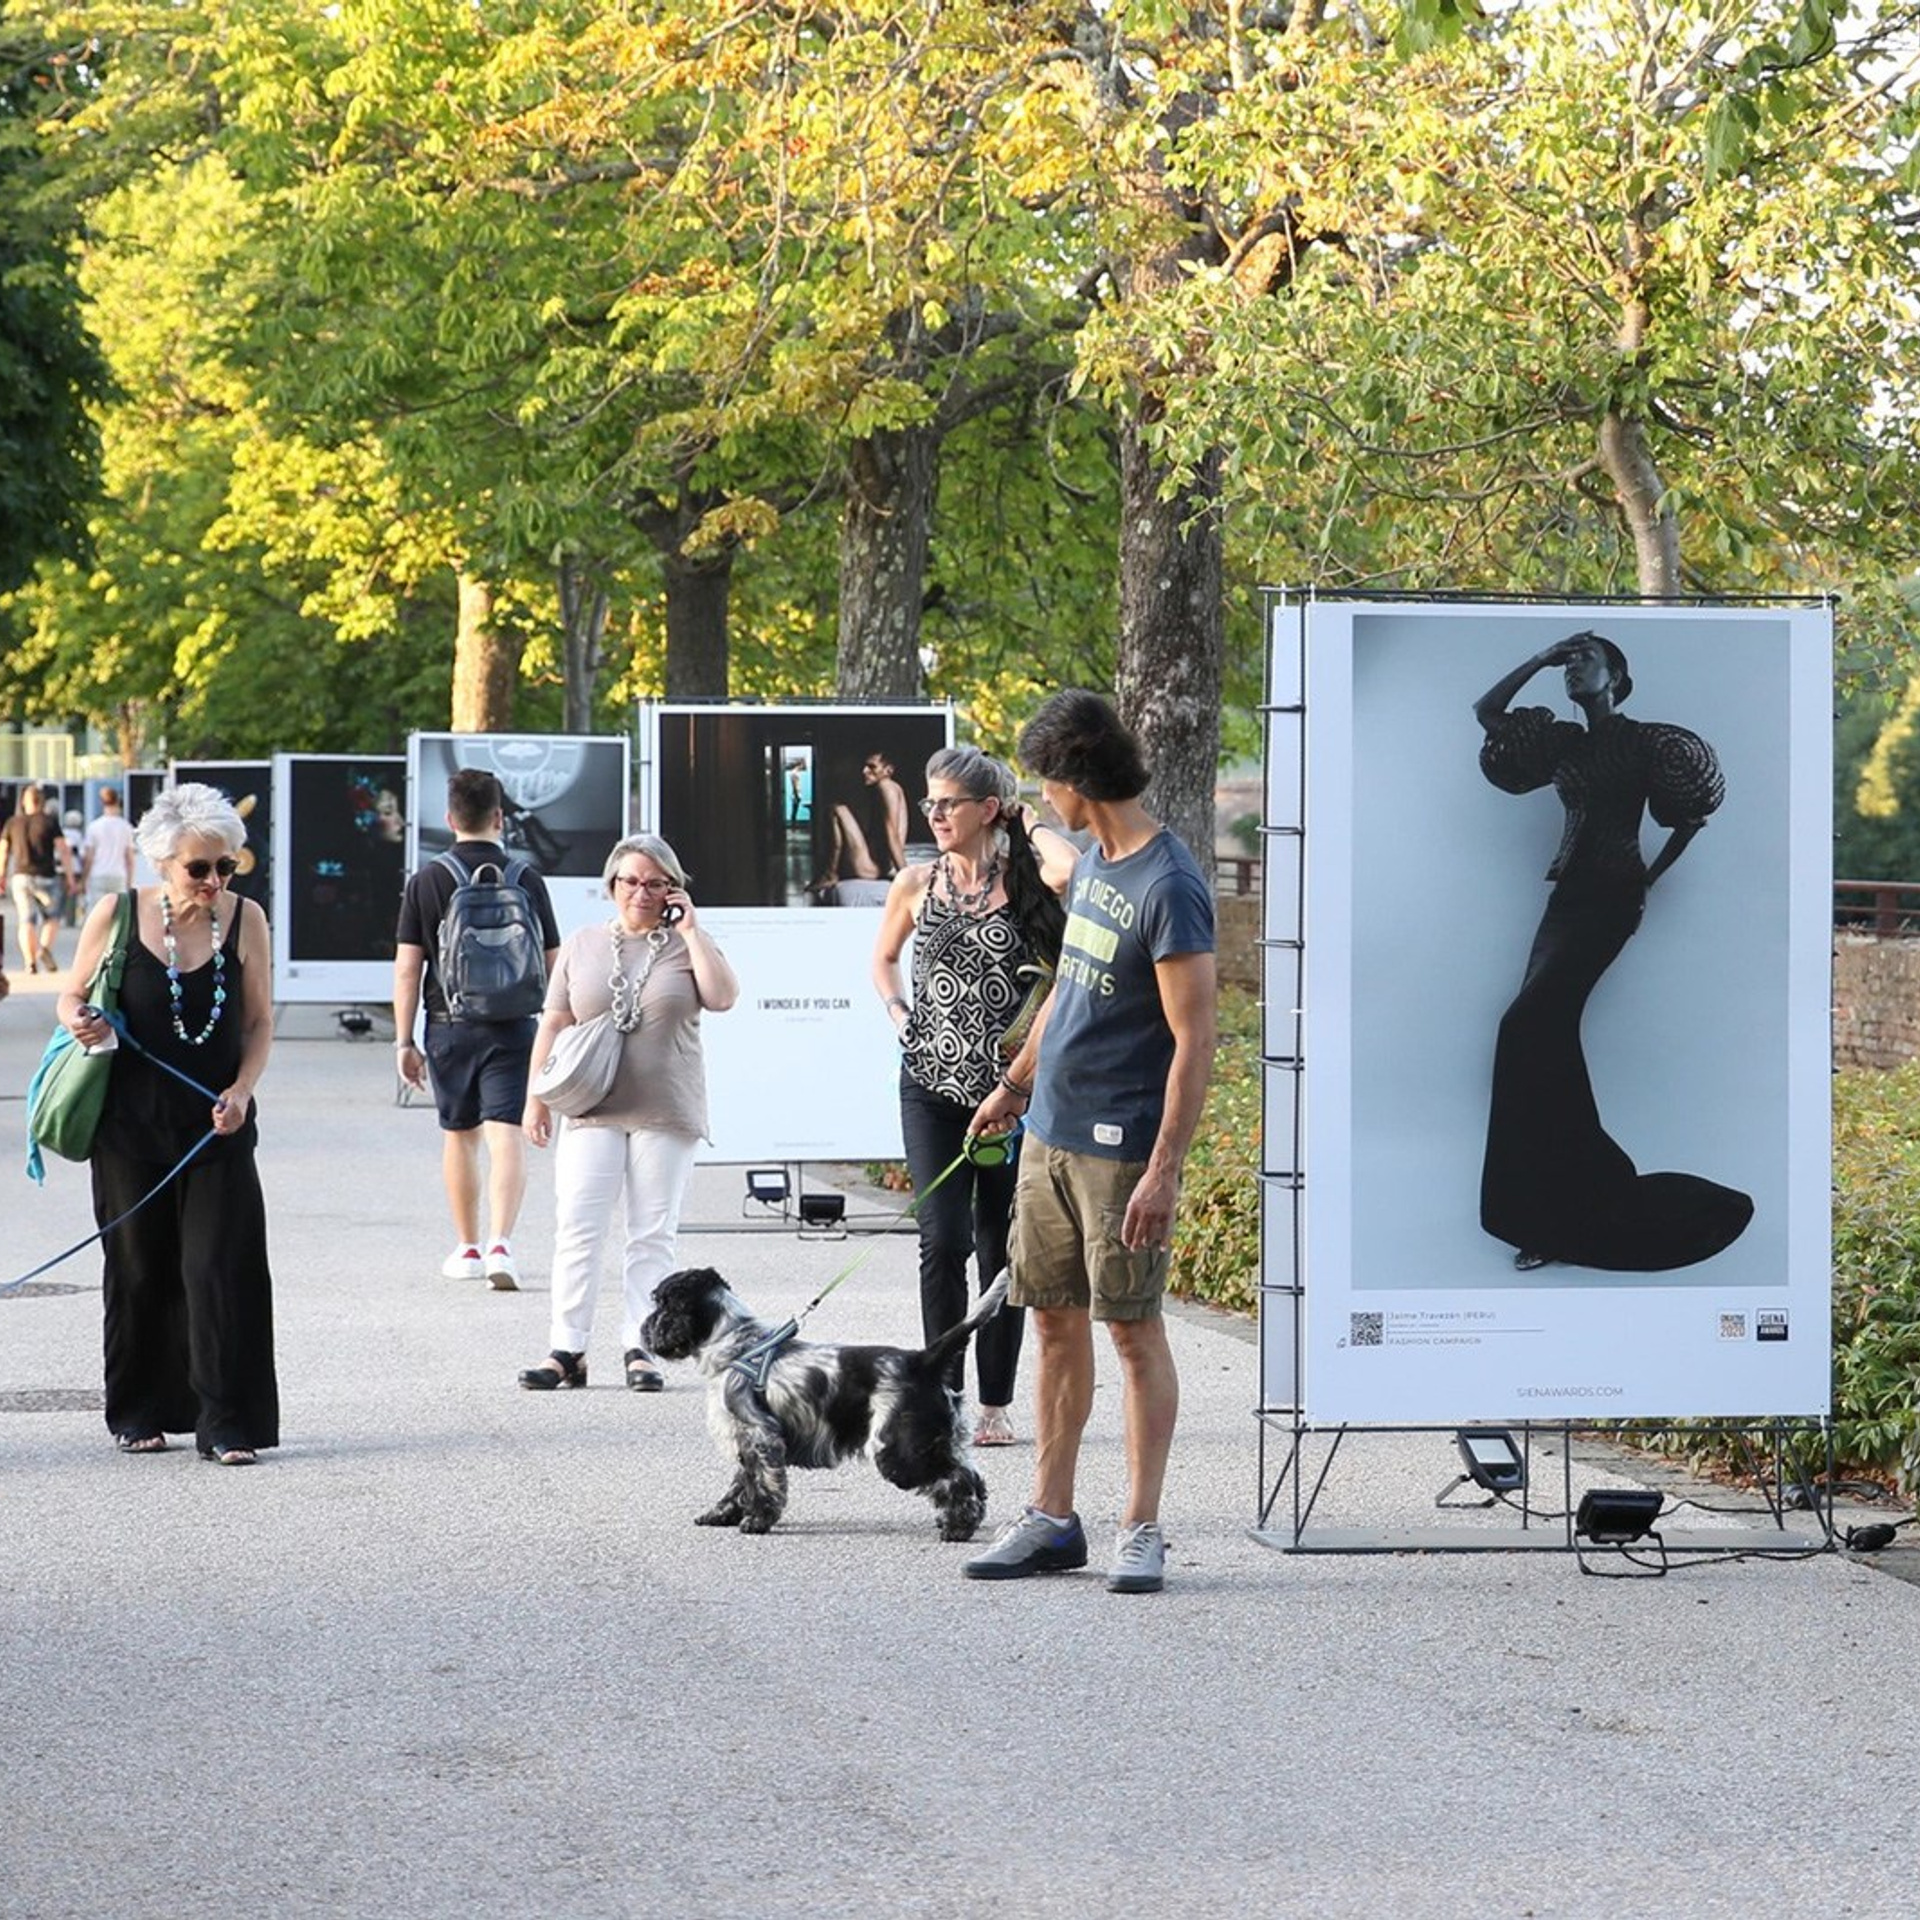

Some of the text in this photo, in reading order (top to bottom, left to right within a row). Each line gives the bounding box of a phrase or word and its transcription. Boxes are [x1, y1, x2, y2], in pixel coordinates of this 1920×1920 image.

[1090, 878, 1135, 929] DIEGO
[763, 998, 800, 1010] WONDER
[802, 998, 811, 1010] IF
[813, 998, 831, 1010] YOU
[832, 998, 851, 1010] CAN
[1760, 1313, 1785, 1324] SIENA
[1720, 1323, 1746, 1338] 2020
[1432, 1337, 1482, 1345] CAMPAIGN
[1516, 1385, 1624, 1398] SIENAWARDS.COM
